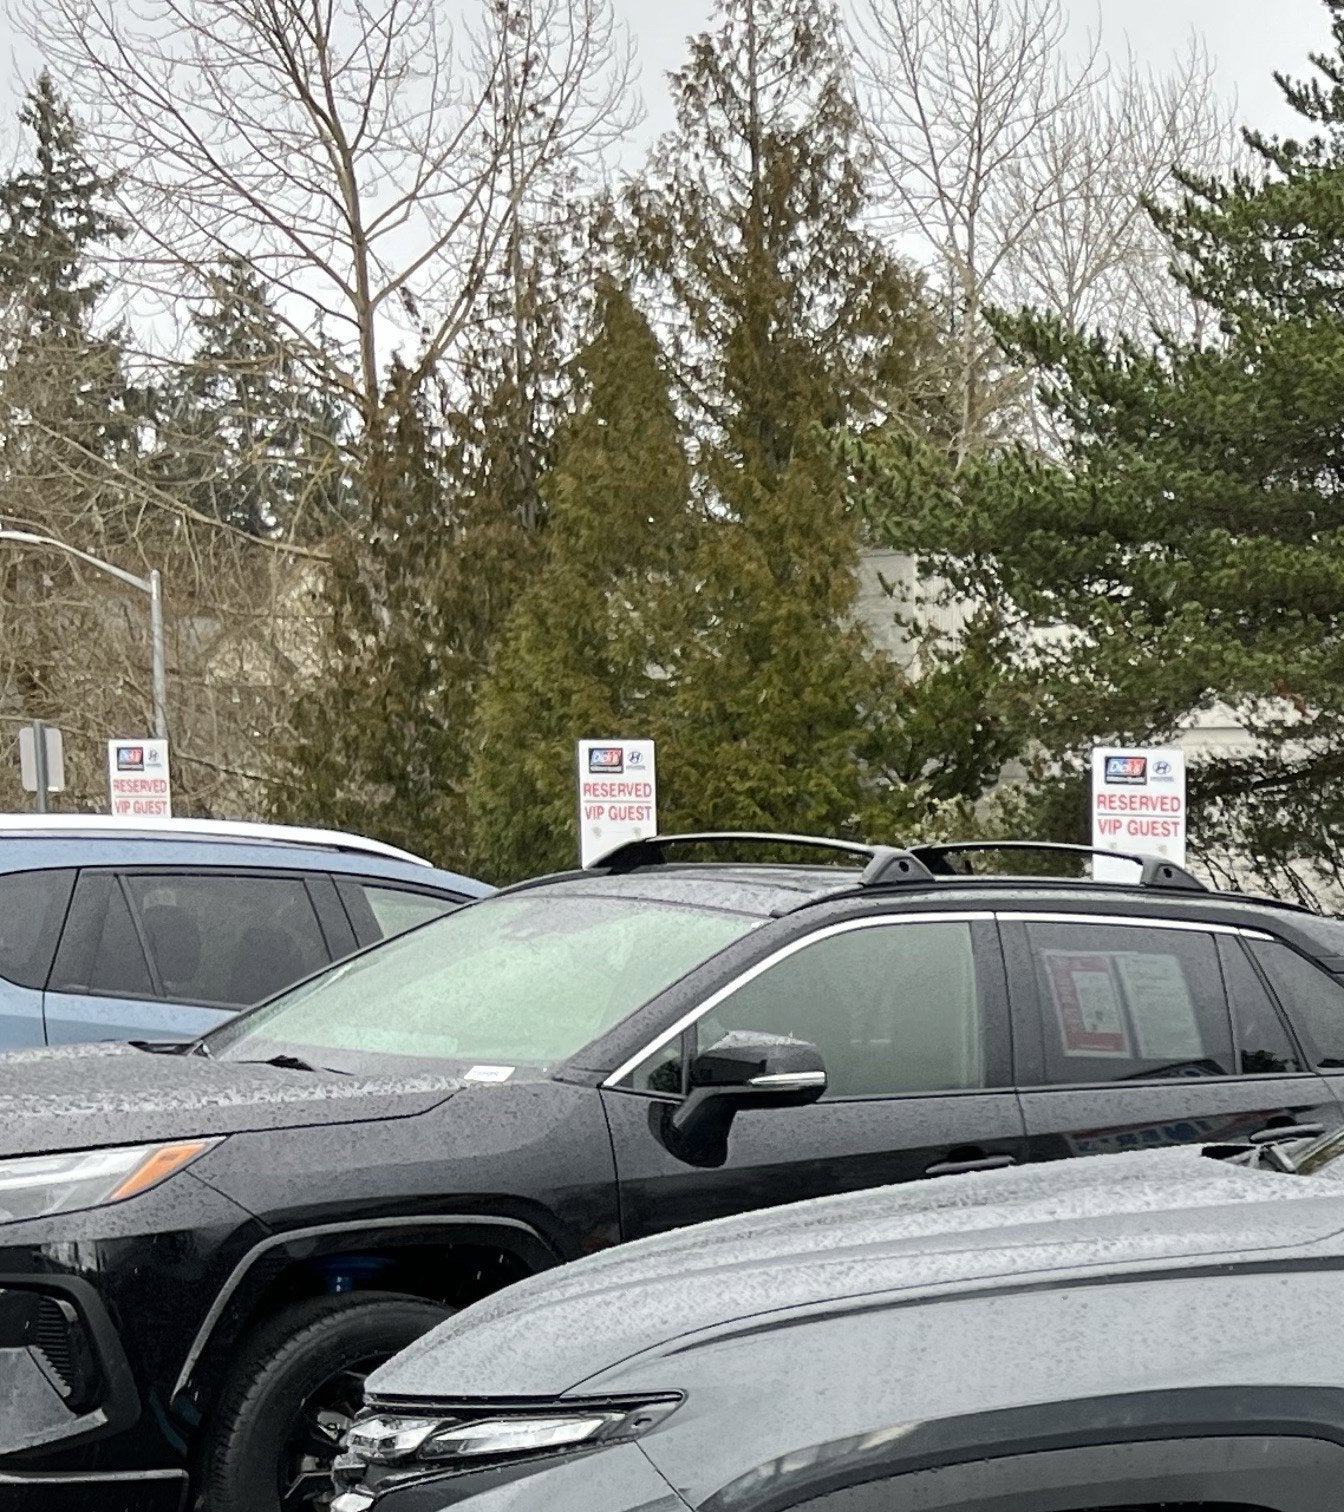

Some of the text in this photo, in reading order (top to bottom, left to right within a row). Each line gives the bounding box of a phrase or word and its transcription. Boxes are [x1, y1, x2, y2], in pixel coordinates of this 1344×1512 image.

[112, 779, 168, 793] RESERVED
[583, 782, 652, 798] RESERVED
[114, 800, 168, 815] VIP GUEST
[1096, 794, 1181, 812] RESERVED
[584, 805, 652, 821] VIP GUEST
[1097, 818, 1180, 837] VIP GUEST
